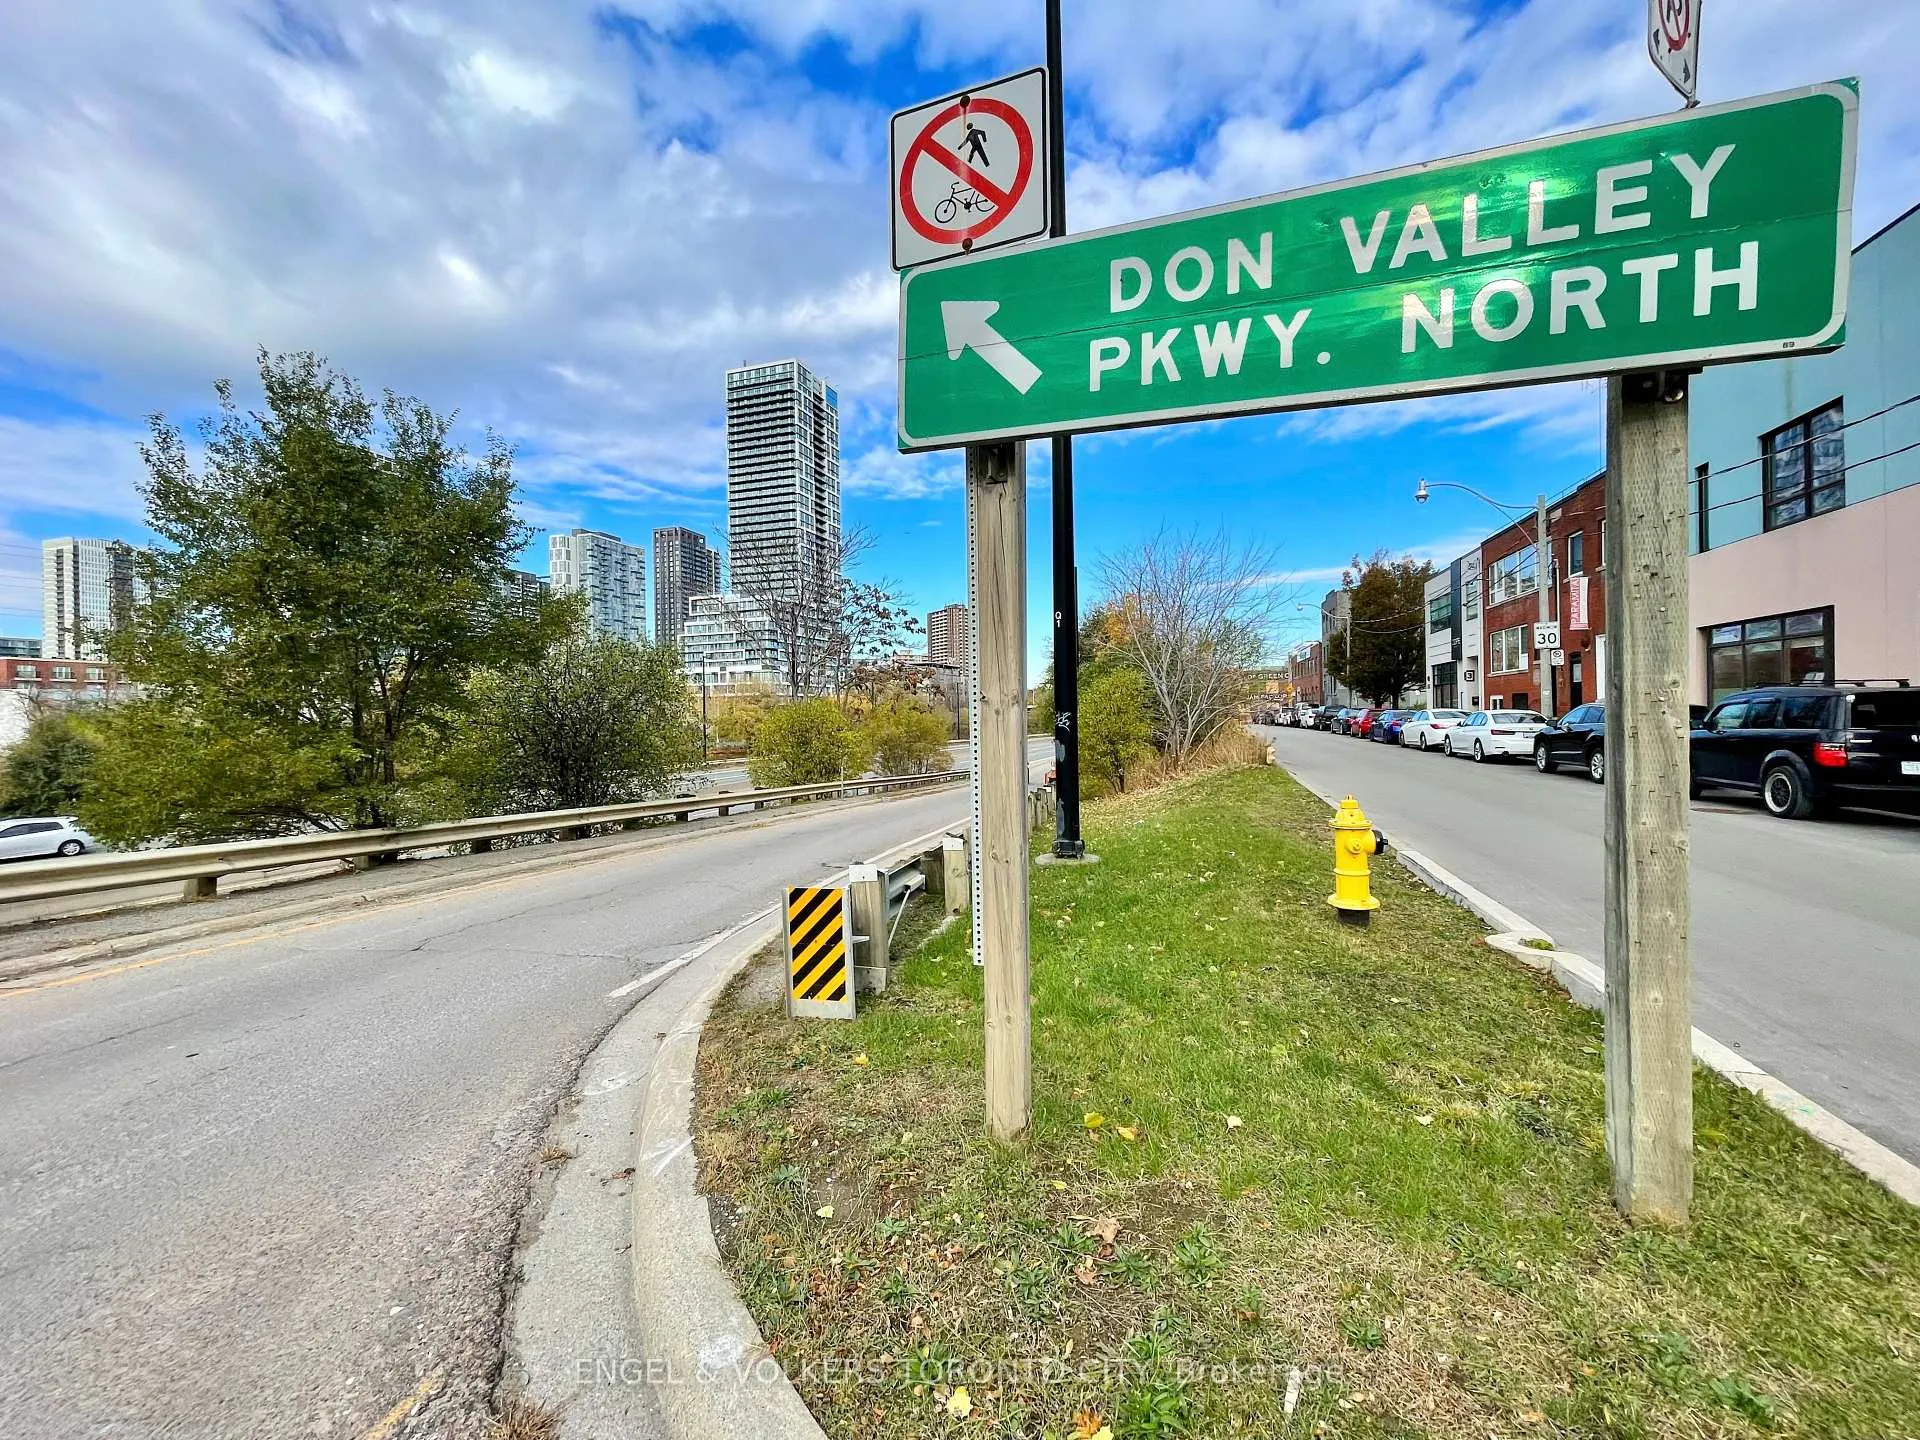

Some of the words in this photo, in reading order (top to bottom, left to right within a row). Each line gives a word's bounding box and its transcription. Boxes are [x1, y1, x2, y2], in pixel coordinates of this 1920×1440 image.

[1110, 231, 1273, 314] DON
[1340, 143, 1737, 275] VALLEY
[1088, 308, 1332, 393] PKWY.
[1401, 240, 1760, 354] NORTH
[1537, 632, 1557, 645] 30
